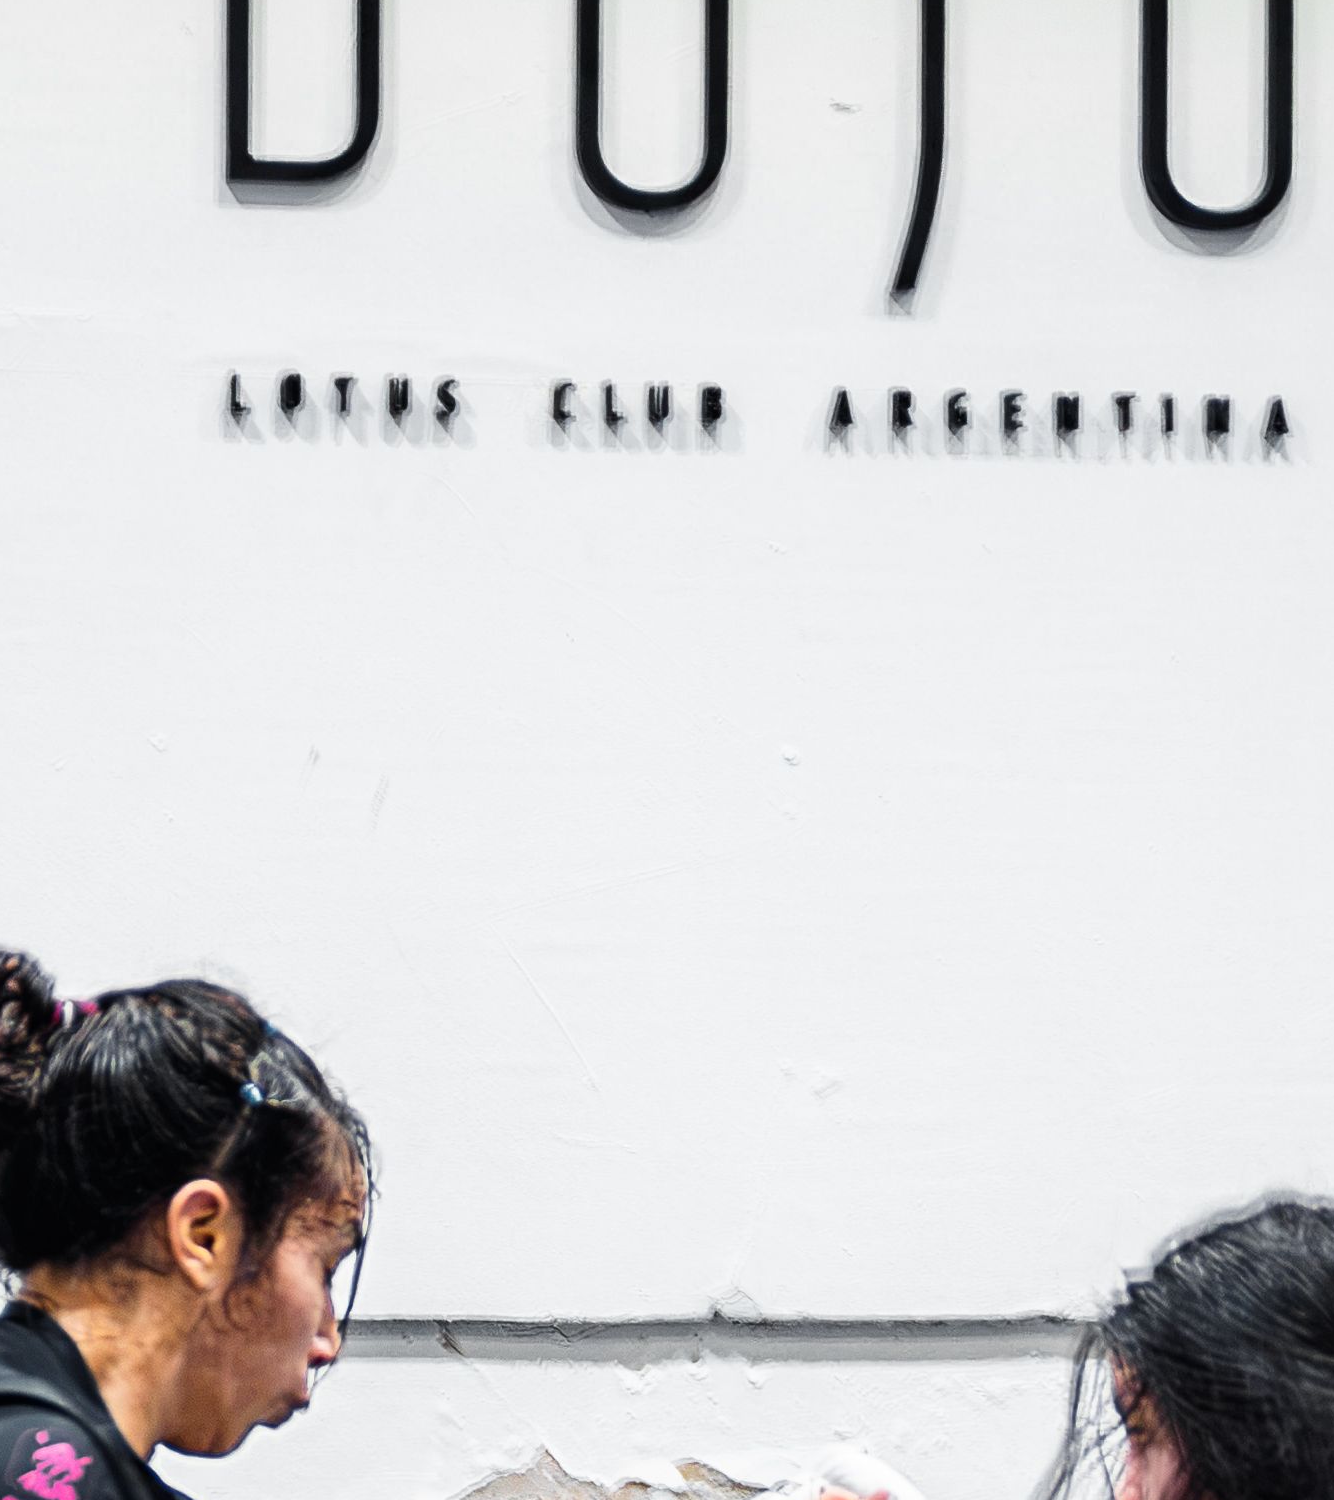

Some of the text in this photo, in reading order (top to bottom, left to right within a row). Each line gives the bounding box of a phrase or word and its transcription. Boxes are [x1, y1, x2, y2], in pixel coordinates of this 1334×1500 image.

[228, 371, 1291, 438] LOTUS CLUB ARGENTINA
